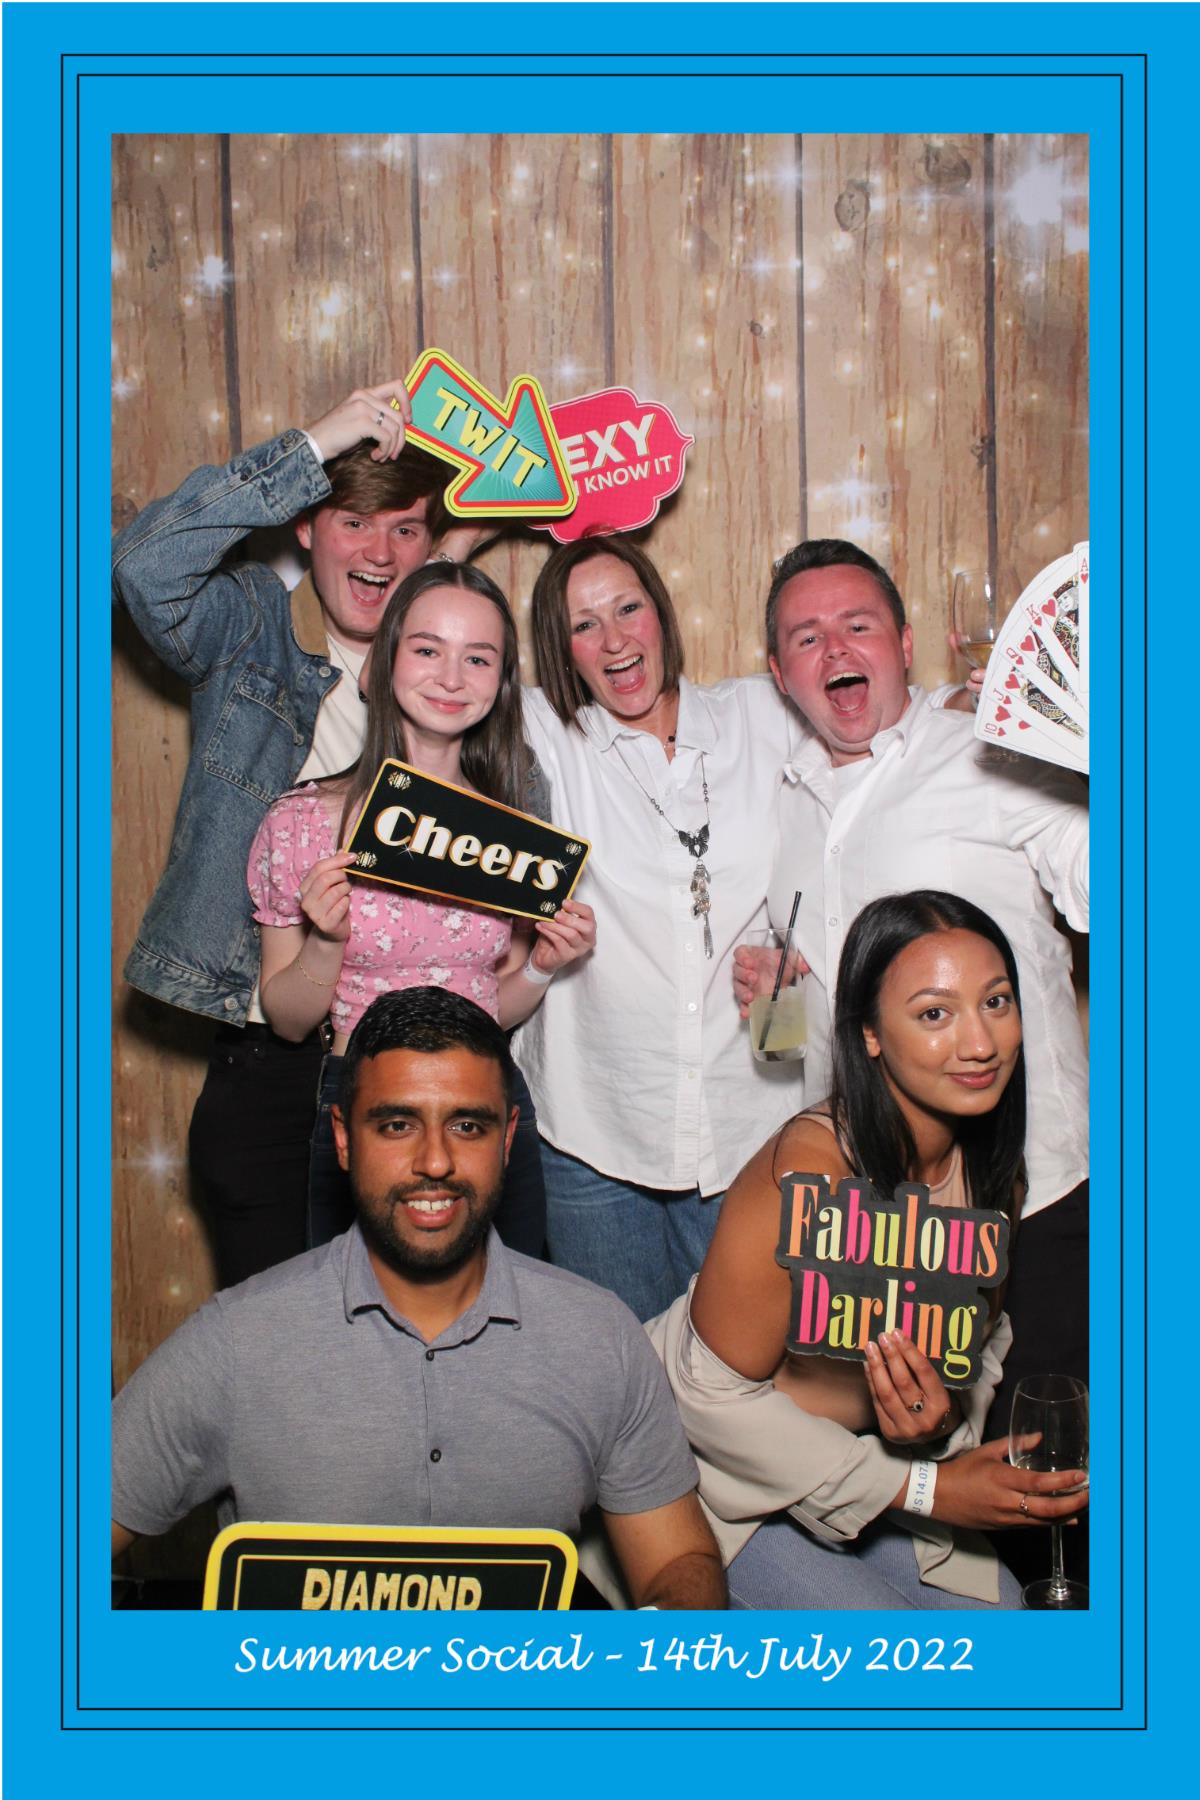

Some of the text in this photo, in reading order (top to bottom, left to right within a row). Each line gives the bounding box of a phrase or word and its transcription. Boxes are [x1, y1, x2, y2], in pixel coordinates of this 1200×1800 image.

[433, 387, 550, 488] TWIT
[559, 413, 656, 475] EXY
[584, 461, 651, 494] KNOW
[654, 454, 673, 476] IT
[1080, 557, 1089, 572] A
[1026, 603, 1039, 620] K
[1006, 647, 1018, 660] Q
[993, 688, 1005, 701] J
[984, 722, 998, 735] 10
[374, 805, 564, 891] Cheers
[785, 1183, 1000, 1278] Fabulous
[795, 1269, 978, 1379] Darling
[301, 1567, 482, 1610] DIAMOND
